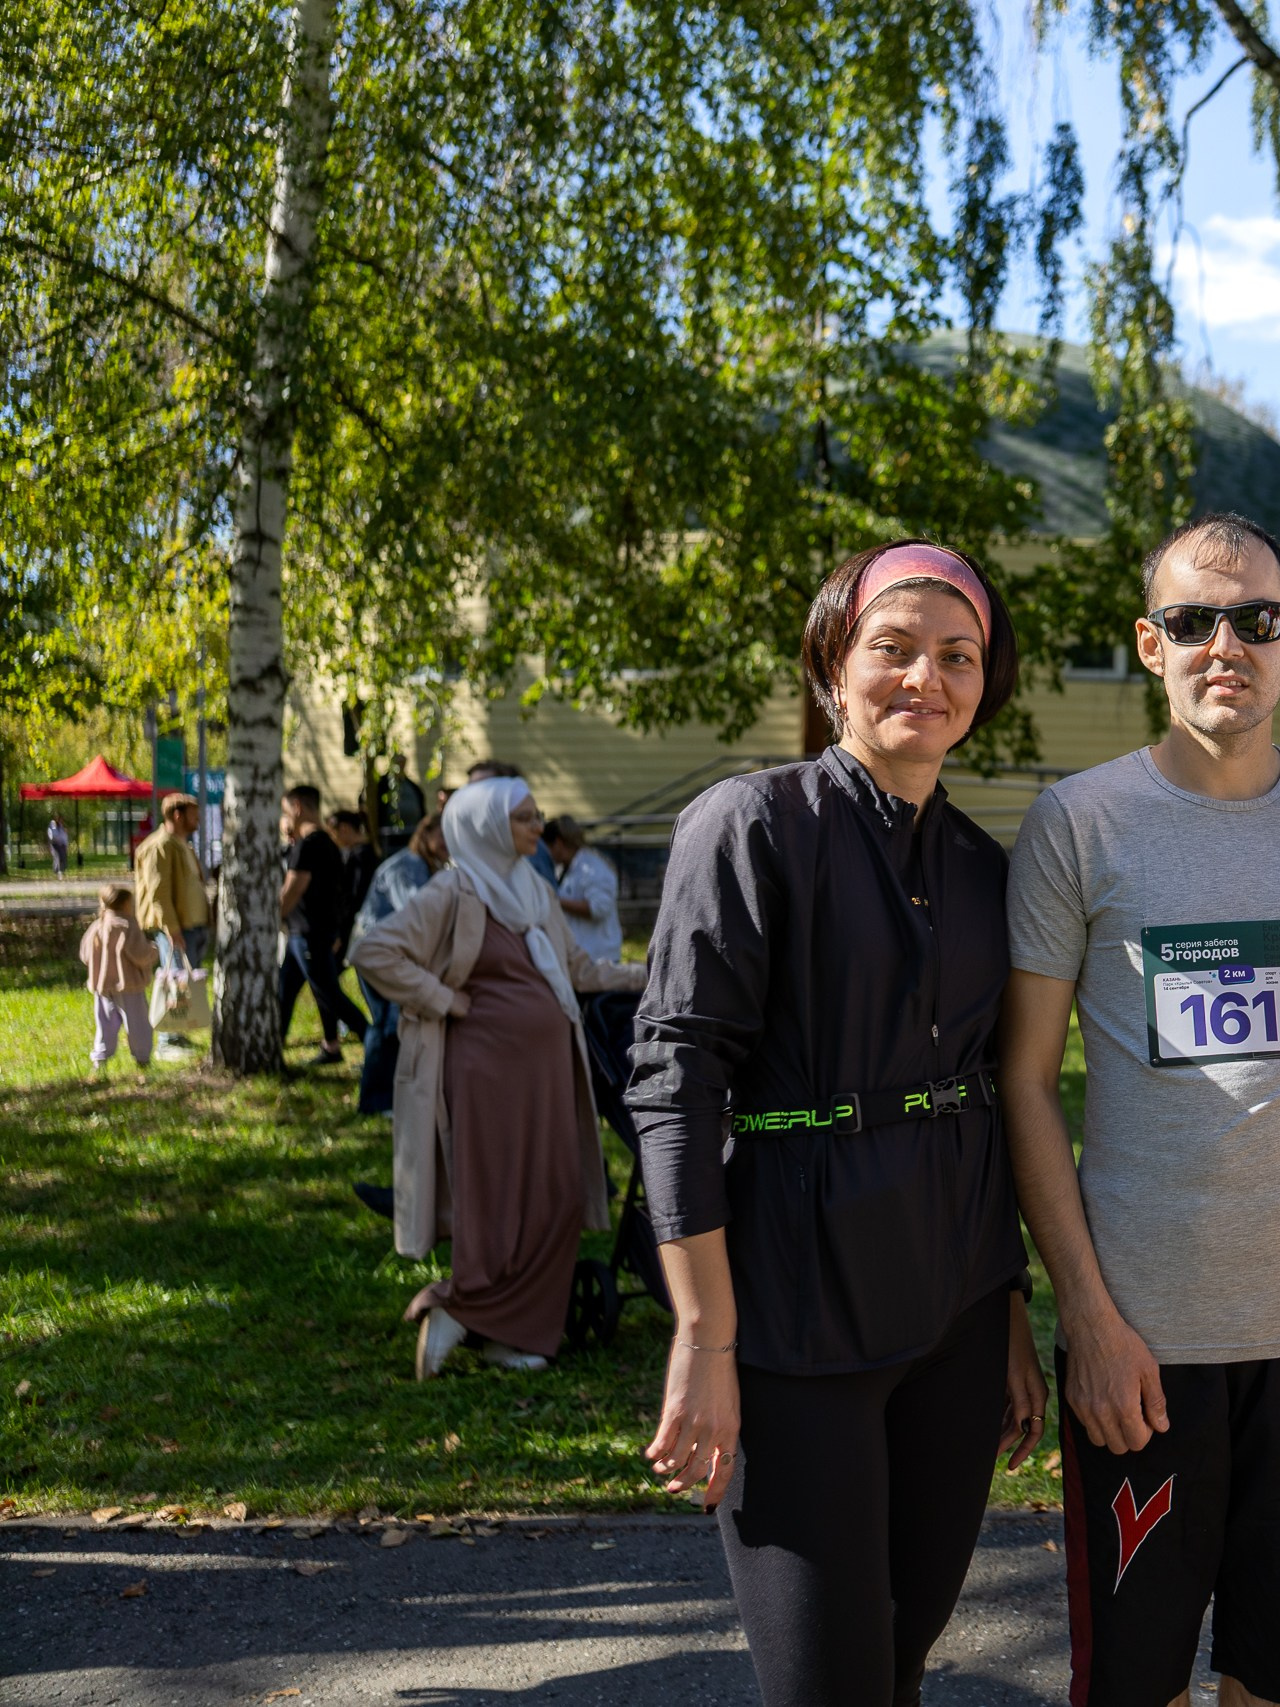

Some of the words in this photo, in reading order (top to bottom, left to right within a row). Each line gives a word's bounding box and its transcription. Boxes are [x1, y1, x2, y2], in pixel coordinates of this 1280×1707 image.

[1175, 940, 1202, 949] серия
[1204, 938, 1239, 948] забегов
[1161, 943, 1174, 962] 5
[1176, 947, 1240, 962] городов
[1224, 969, 1231, 978] 2
[1180, 990, 1279, 1047] 161
